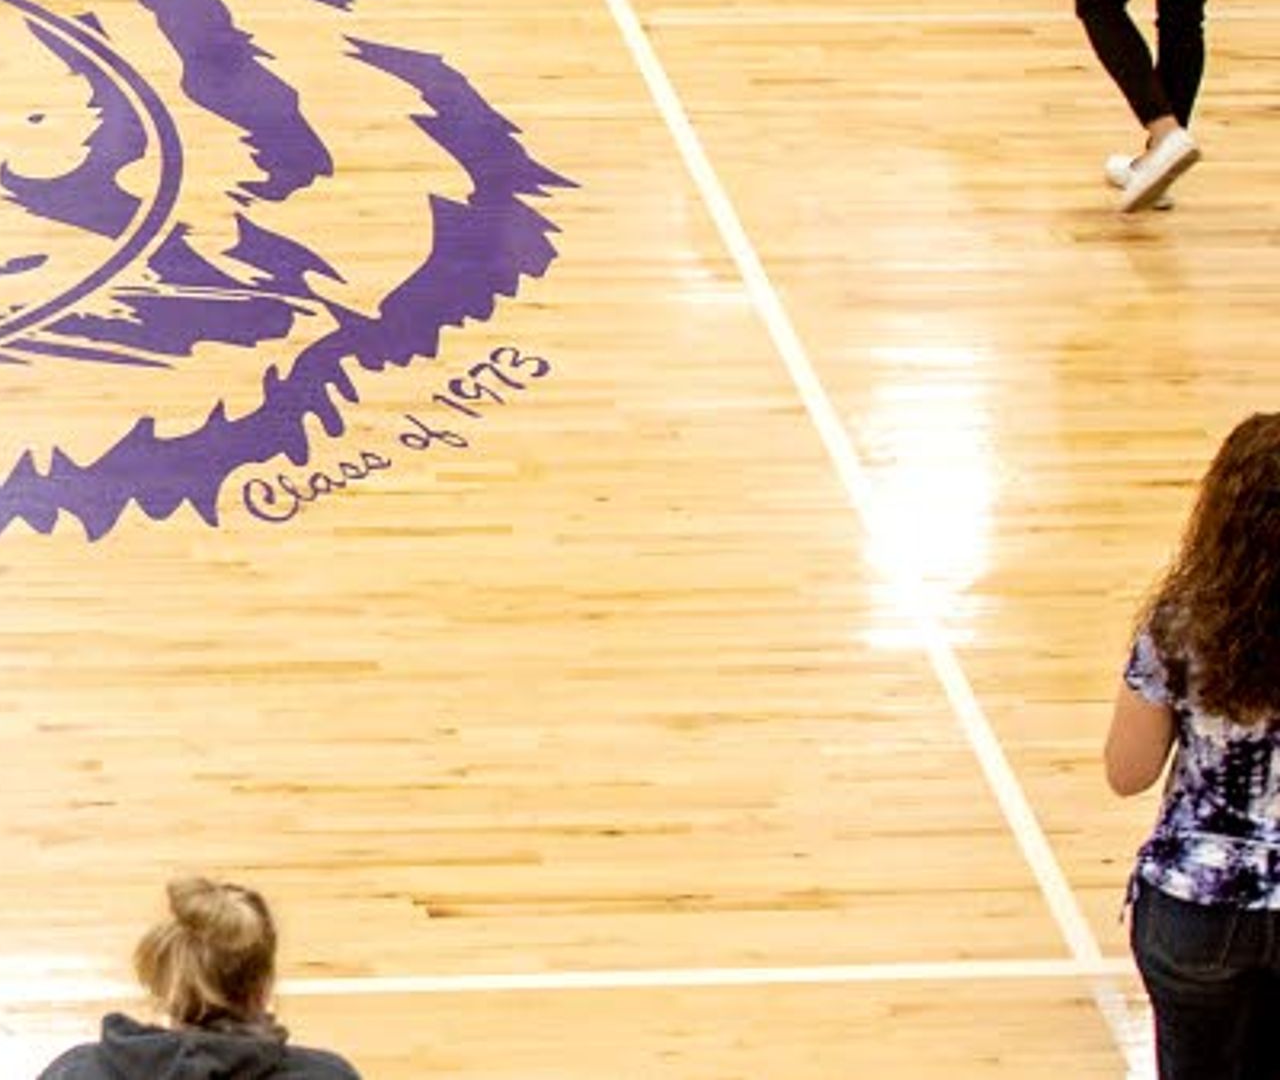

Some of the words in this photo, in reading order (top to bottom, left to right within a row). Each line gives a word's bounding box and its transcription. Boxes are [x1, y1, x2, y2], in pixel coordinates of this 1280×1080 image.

[431, 346, 551, 419] 1973
[398, 414, 470, 452] of
[242, 451, 392, 523] Class
